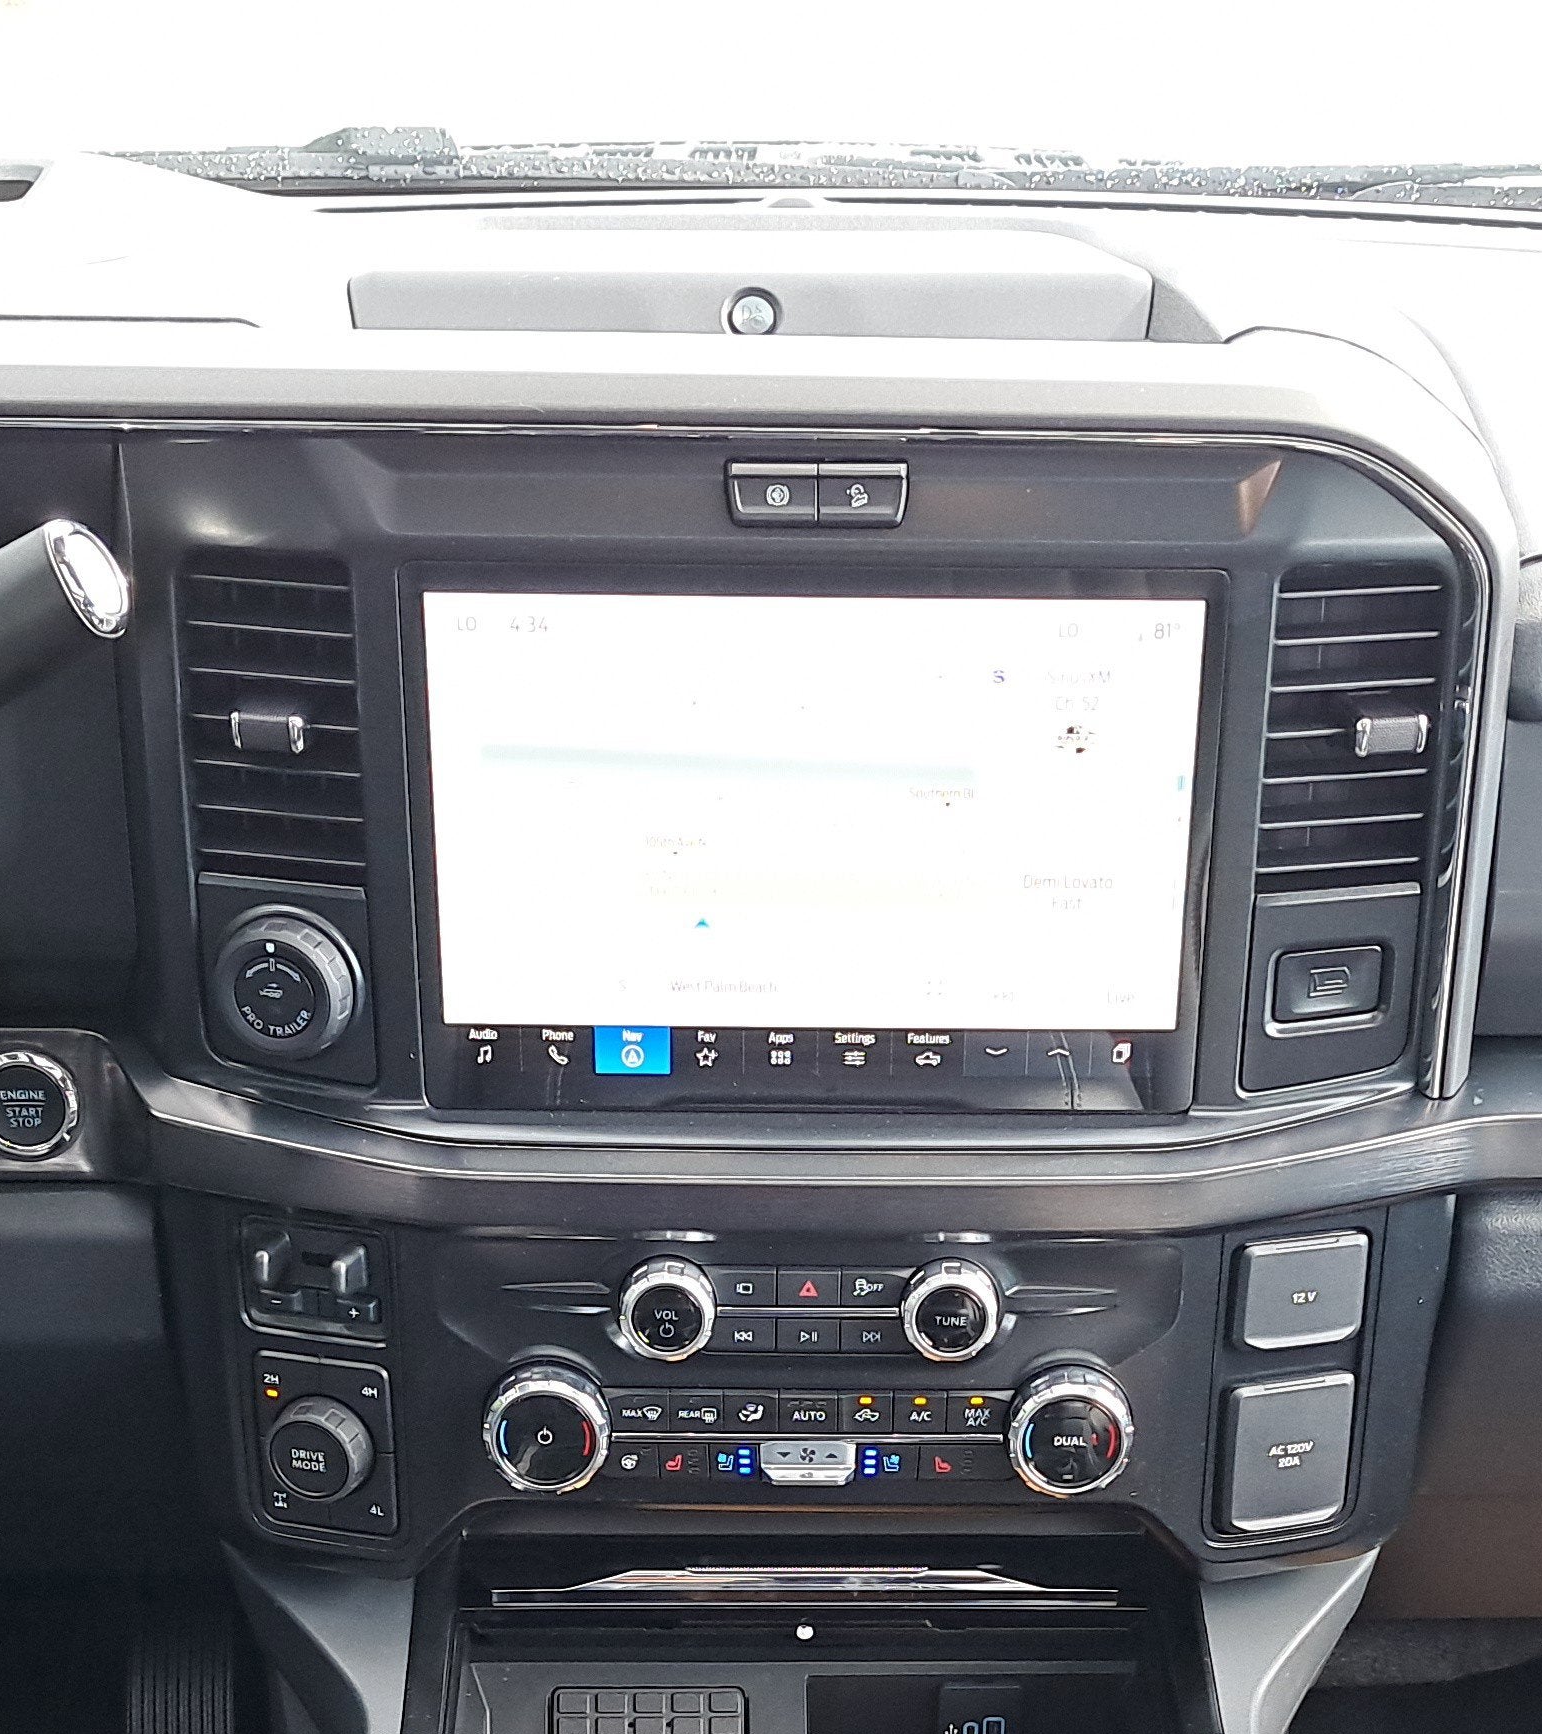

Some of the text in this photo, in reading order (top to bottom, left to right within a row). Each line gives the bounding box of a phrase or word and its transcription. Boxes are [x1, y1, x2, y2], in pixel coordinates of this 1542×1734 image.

[509, 615, 548, 632] 434
[241, 1004, 312, 1037] PRO TRAILER
[468, 1028, 498, 1041] Audio
[541, 1029, 574, 1042] Phone
[697, 1031, 717, 1043] Fav
[767, 1031, 794, 1046] Apps
[834, 1032, 876, 1046] Settings
[907, 1032, 951, 1045] Features
[0, 1089, 47, 1102] ENGINE
[5, 1106, 44, 1120] START
[9, 1115, 43, 1129] STOP
[866, 1283, 884, 1292] OFF
[654, 1309, 679, 1321] VOL
[934, 1315, 968, 1328] TUNE
[263, 1373, 280, 1385] 2H
[361, 1386, 378, 1398] 4H
[622, 1409, 643, 1419] MAX
[678, 1411, 701, 1420] REAR
[792, 1410, 826, 1422] AUTO
[909, 1411, 932, 1422] A/C
[964, 1408, 991, 1419] MAX
[966, 1417, 988, 1427] A/C
[1053, 1435, 1087, 1448] DUAL
[291, 1448, 325, 1462] DRIVE
[292, 1459, 327, 1473] MODE
[369, 1504, 385, 1517] 4L
